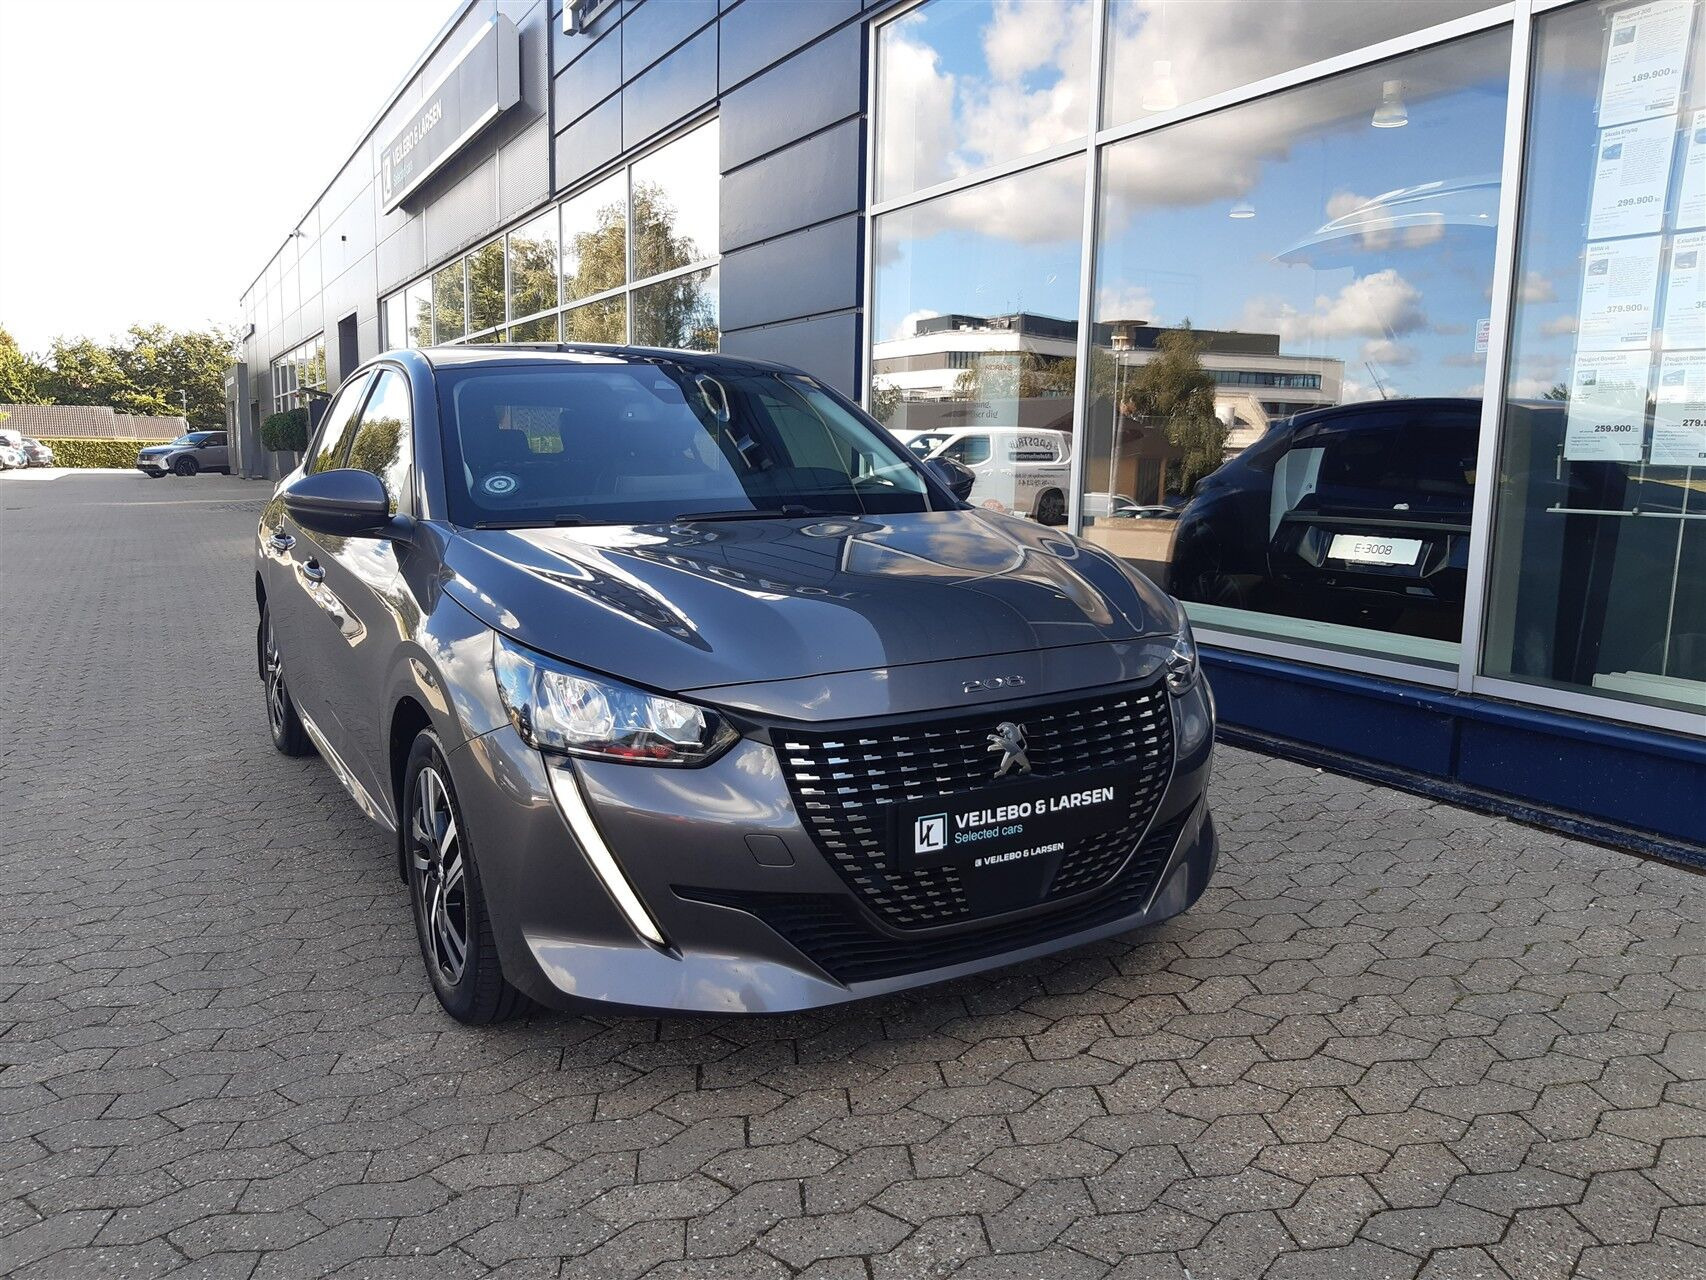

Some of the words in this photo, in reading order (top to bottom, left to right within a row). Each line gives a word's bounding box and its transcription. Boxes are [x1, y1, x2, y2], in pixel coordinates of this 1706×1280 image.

[1631, 67, 1671, 83] 189.900
[392, 130, 414, 167] VEJLEBO
[418, 99, 442, 141] LARSEN
[1617, 195, 1654, 208] 299.900
[1606, 303, 1643, 313] 379.900
[1664, 355, 1689, 363] Peugeot
[1594, 425, 1632, 433] 259.900
[1353, 543, 1393, 555] E-3008
[962, 675, 1026, 693] 208
[955, 802, 1032, 829] VEJLEBO
[1035, 800, 1046, 815] &
[1050, 786, 1114, 812] LARSEN
[954, 826, 999, 844] Selected
[1001, 823, 1023, 836] cars
[984, 851, 1022, 866] VEJLEBO
[1023, 849, 1029, 858] &
[1030, 842, 1064, 856] LARSEN
